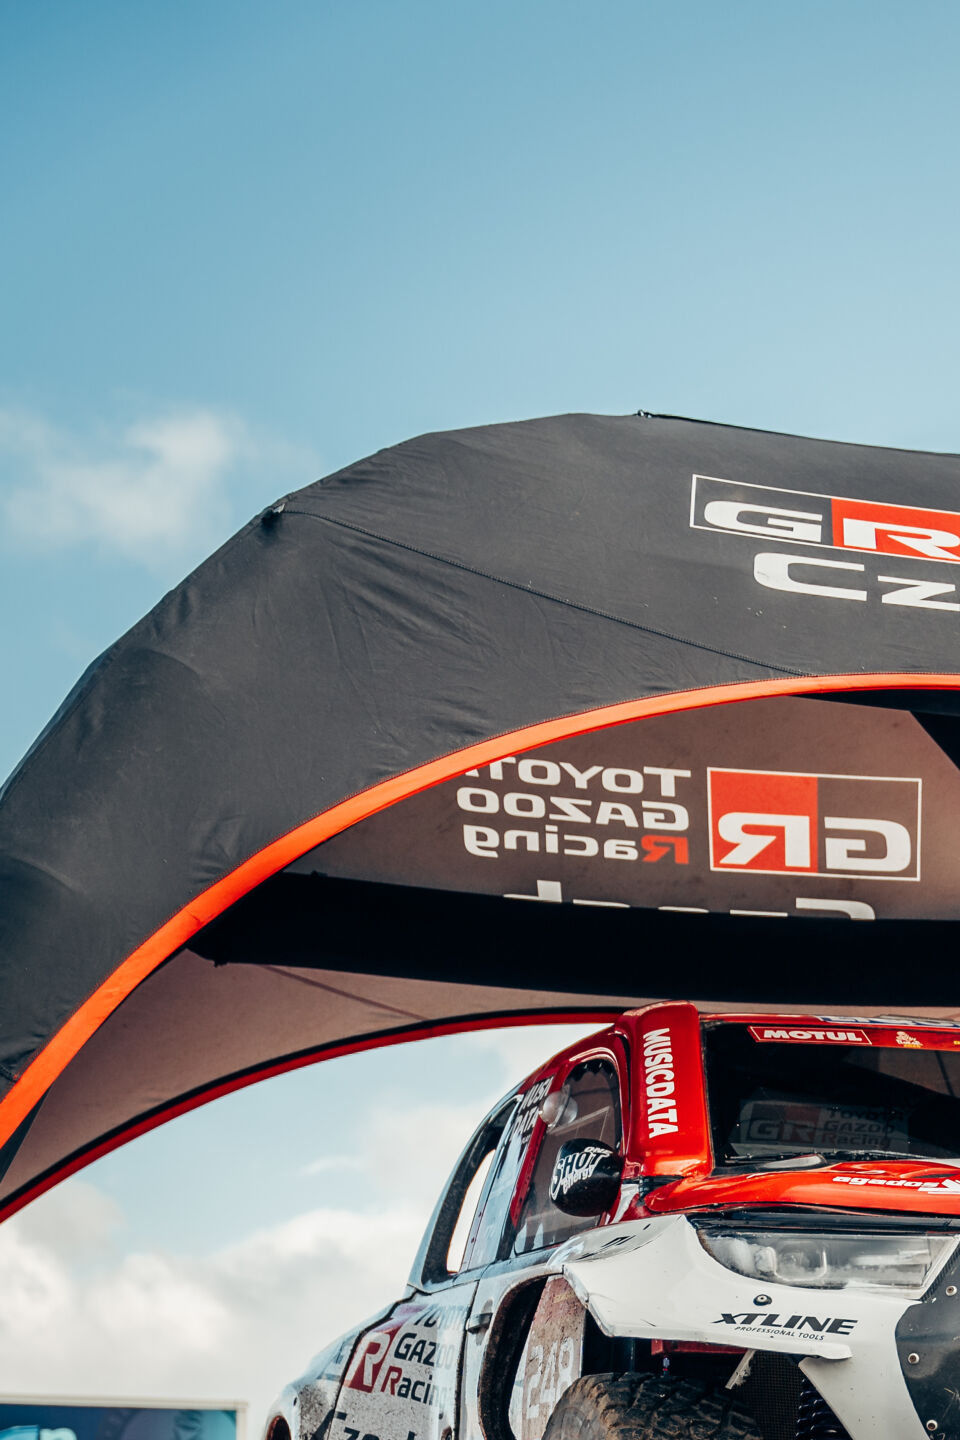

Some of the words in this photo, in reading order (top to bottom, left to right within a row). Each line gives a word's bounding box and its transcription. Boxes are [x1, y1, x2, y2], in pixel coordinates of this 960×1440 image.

[763, 1029, 863, 1042] MOTUL
[642, 1027, 679, 1139] MUSICDATA
[832, 1174, 941, 1190] agados
[711, 1313, 858, 1335] XTLINE
[734, 1326, 796, 1337] PROFESSIONAL
[798, 1331, 825, 1341] TOOLS
